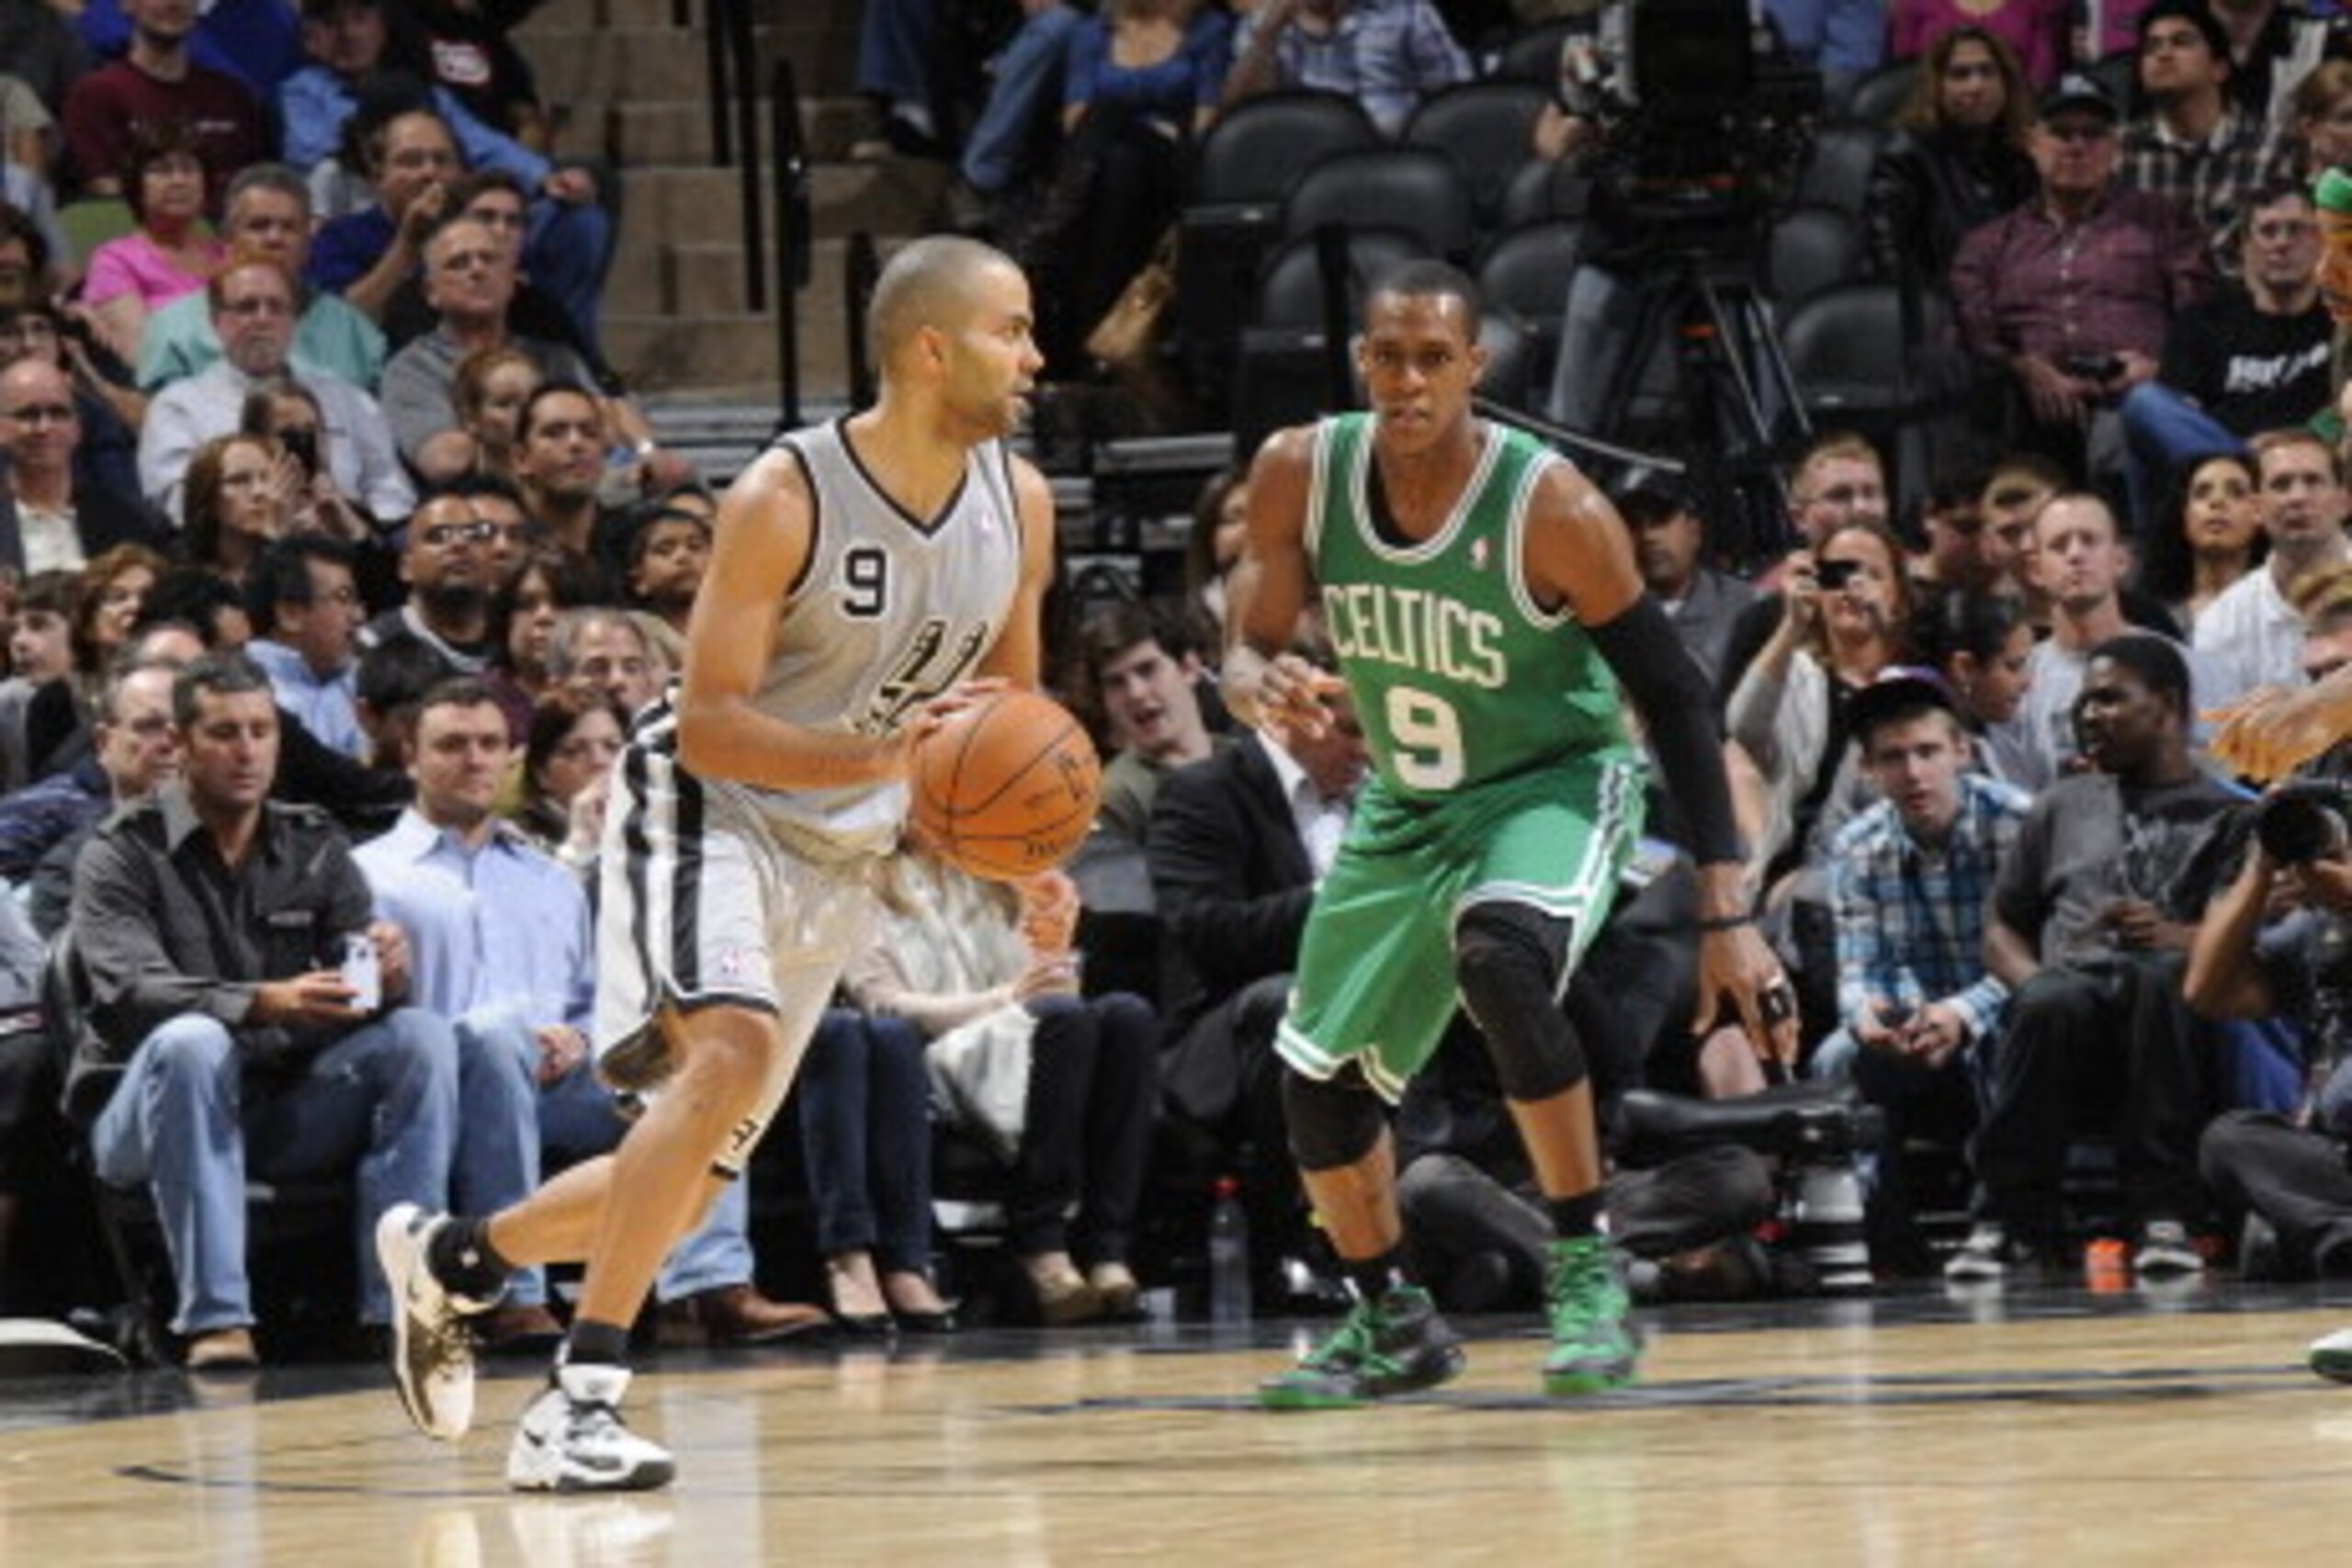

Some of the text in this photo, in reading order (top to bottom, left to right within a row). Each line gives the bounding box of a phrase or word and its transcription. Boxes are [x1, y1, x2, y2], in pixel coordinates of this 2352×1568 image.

[842, 547, 888, 618] 9
[1322, 583, 1507, 688] CELTICS
[1385, 685, 1465, 790] 9
